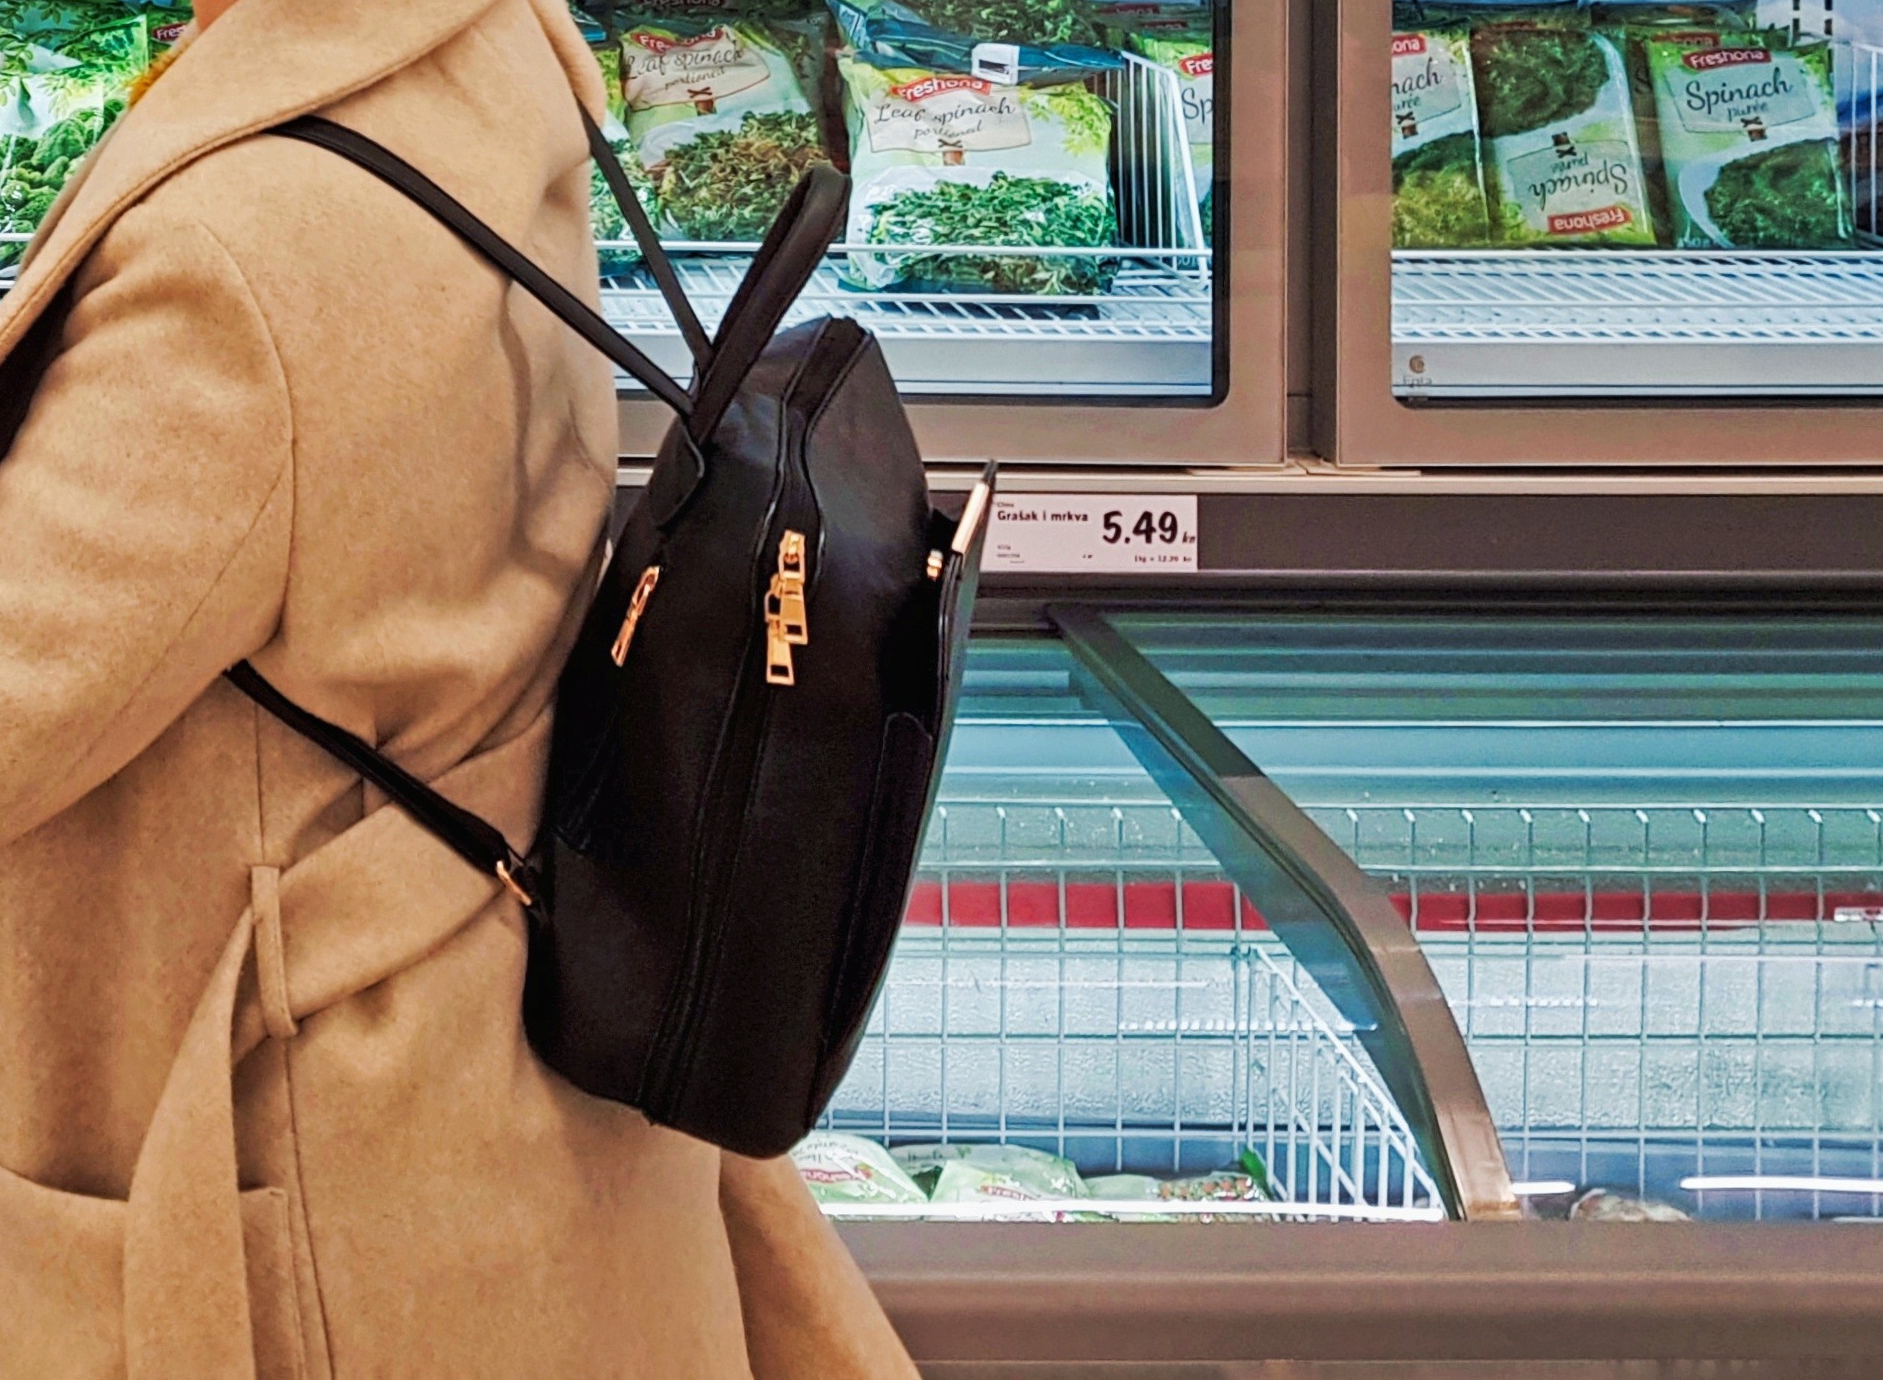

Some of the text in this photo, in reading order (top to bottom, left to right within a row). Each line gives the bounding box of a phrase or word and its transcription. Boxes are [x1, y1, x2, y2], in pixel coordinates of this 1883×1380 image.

[1689, 50, 1765, 68] Freshona
[898, 78, 984, 101] Freshona
[1685, 67, 1794, 114] Spinach
[873, 102, 927, 125] Leaf
[1528, 159, 1628, 211] Spinach
[1554, 208, 1625, 230] Freshona
[997, 510, 1088, 522] Grašak i mrkva
[1102, 510, 1196, 545] 5.49 kn
